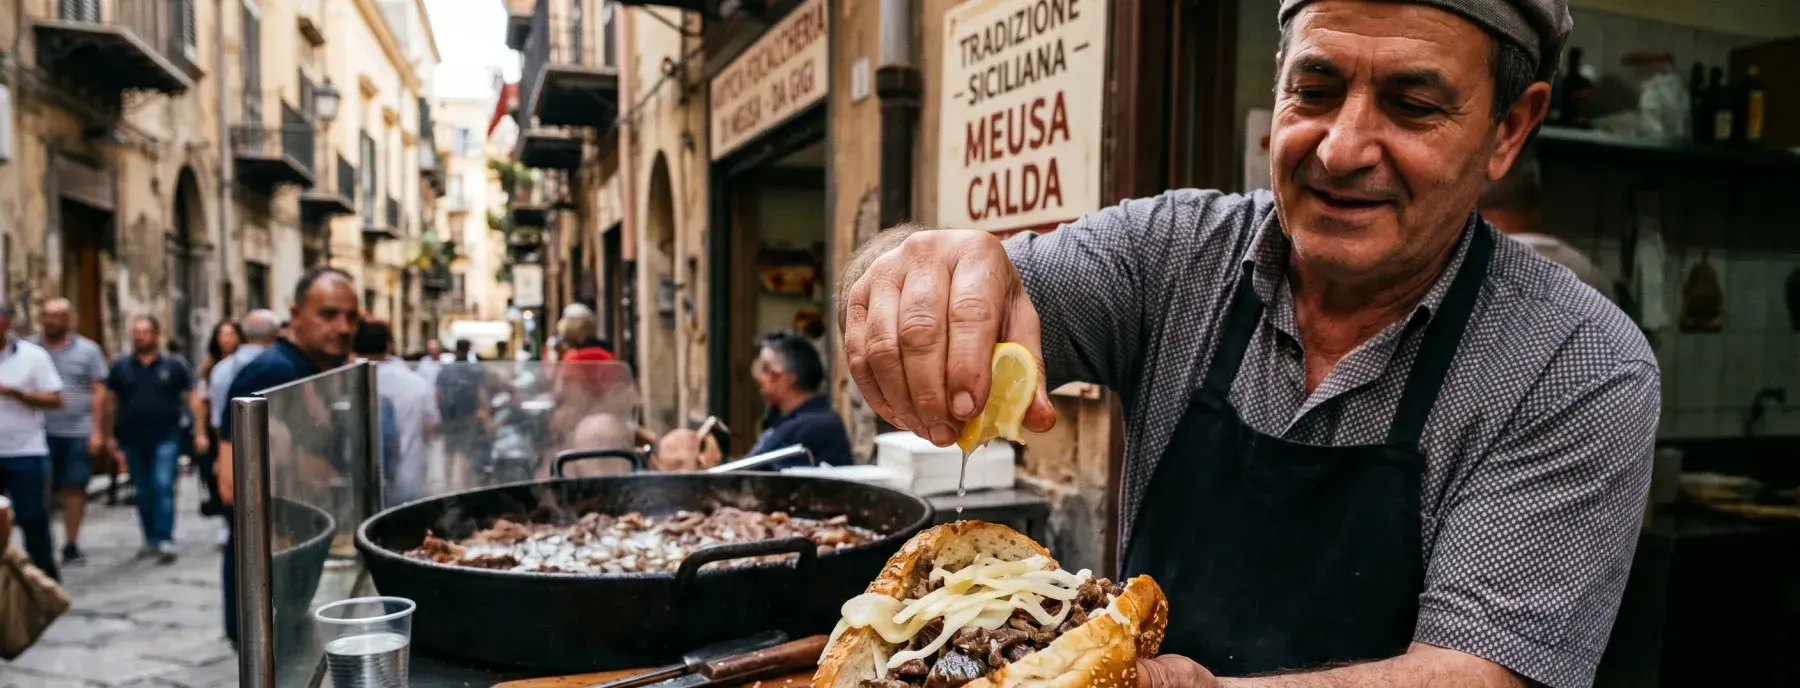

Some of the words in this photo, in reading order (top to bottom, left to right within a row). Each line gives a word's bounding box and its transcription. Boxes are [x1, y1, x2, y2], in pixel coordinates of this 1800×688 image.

[960, 0, 1080, 69] TRADIZIONE
[968, 38, 1066, 106] SICILIANA
[965, 90, 1070, 168] MEUSA
[967, 157, 1063, 221] CALDA
